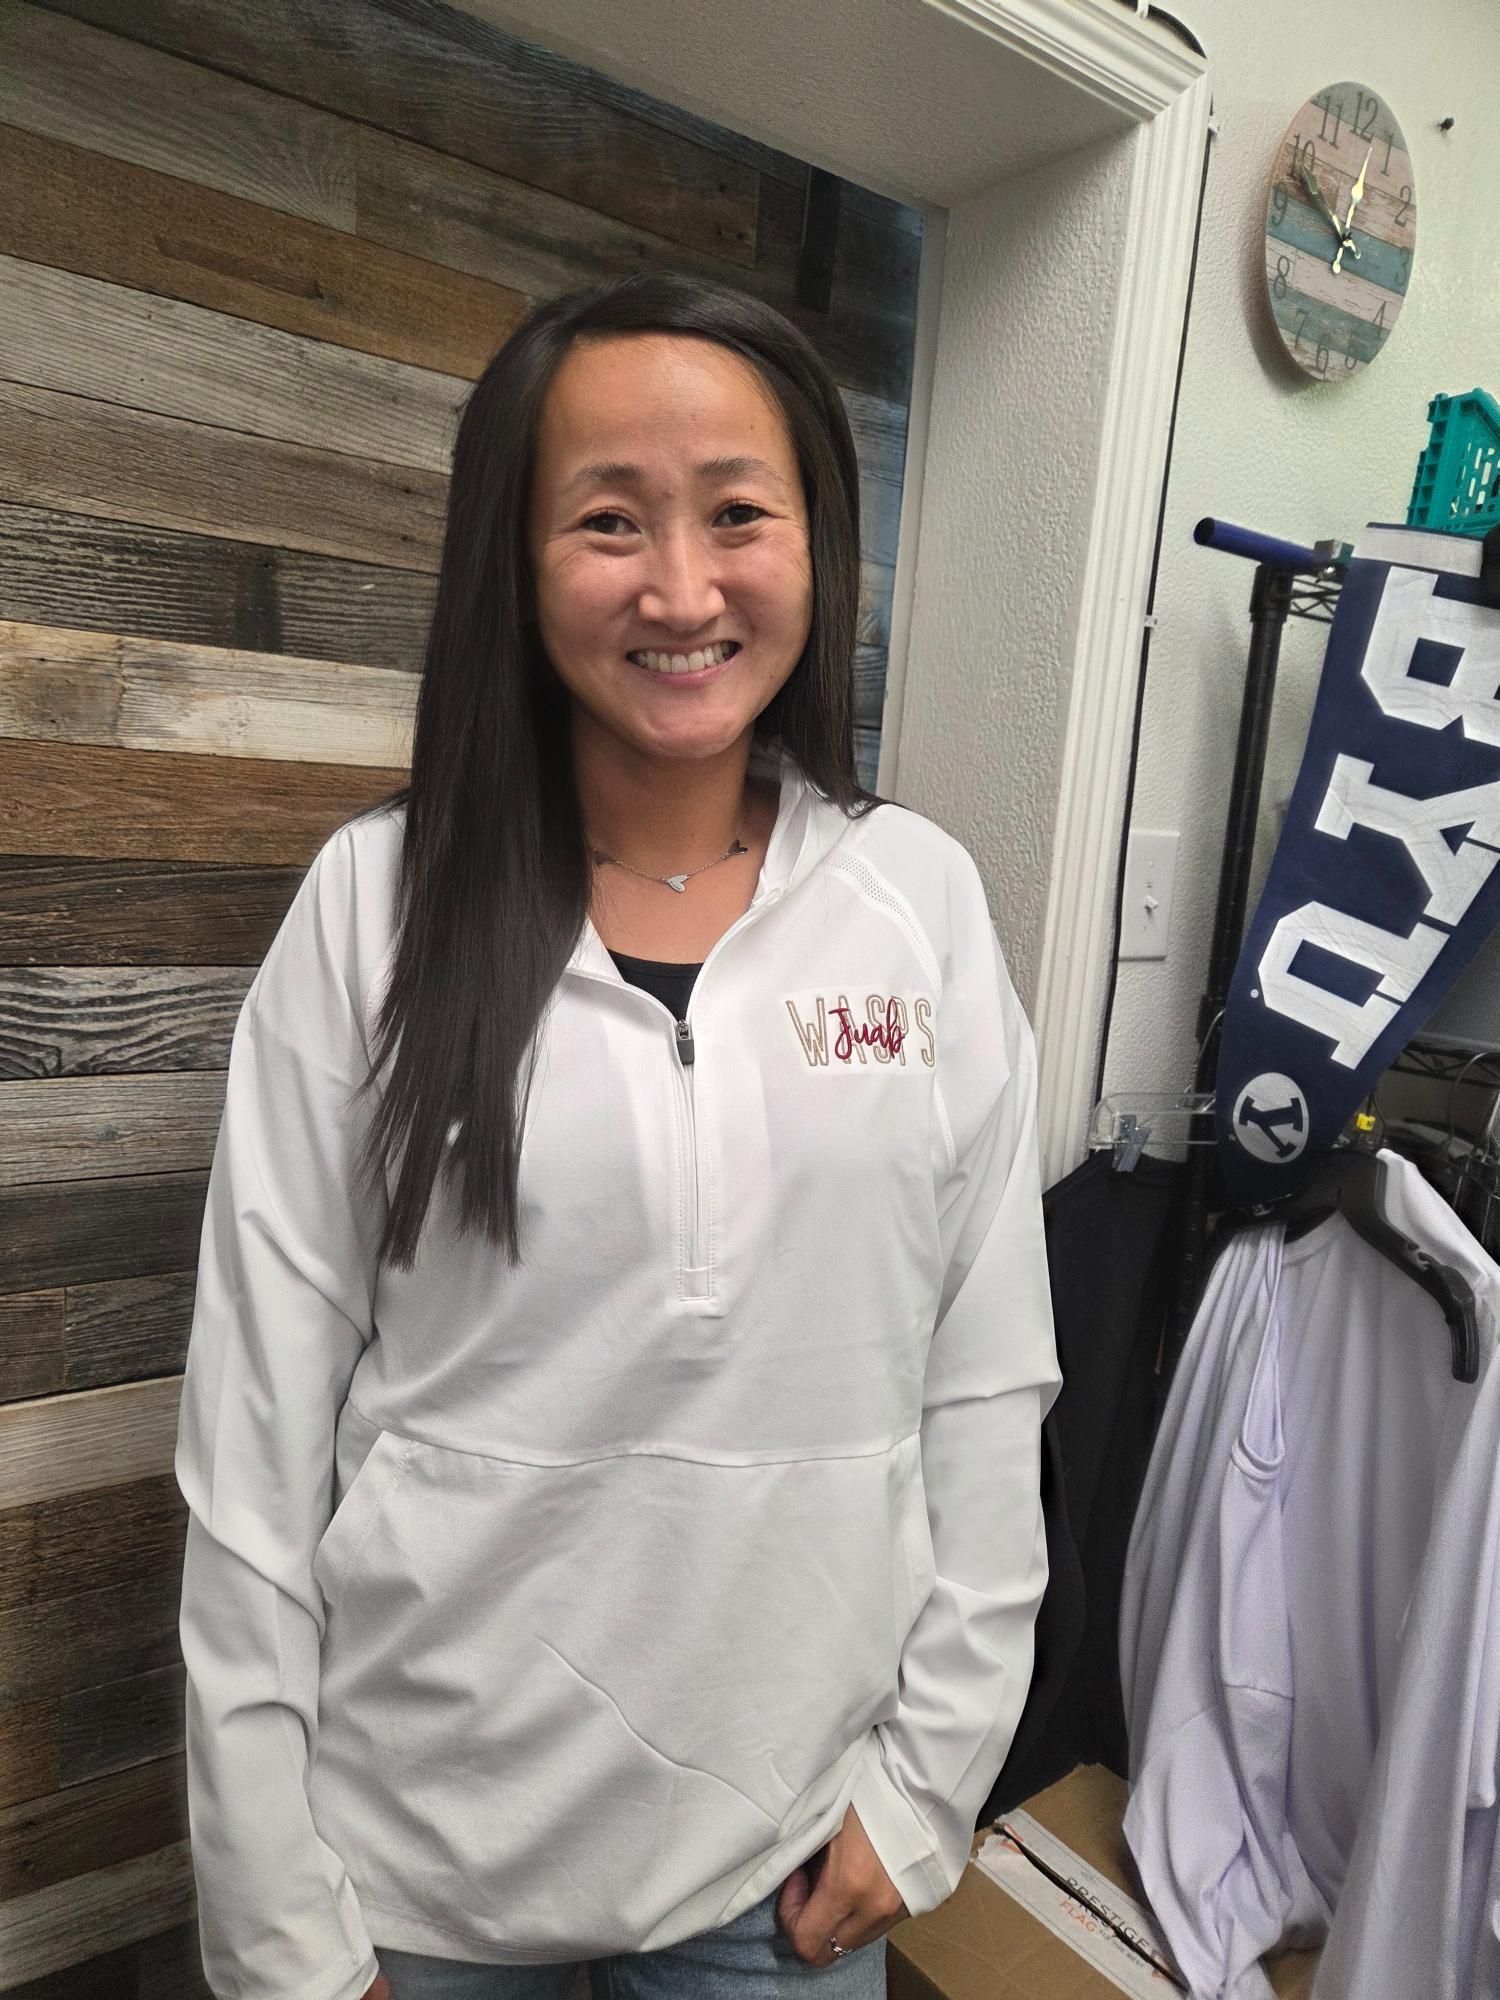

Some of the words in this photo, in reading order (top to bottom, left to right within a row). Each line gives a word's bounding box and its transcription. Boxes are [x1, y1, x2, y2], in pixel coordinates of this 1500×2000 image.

[1317, 95, 1343, 150] 11
[1350, 91, 1378, 143] 12
[1287, 133, 1316, 177] 10
[1380, 132, 1395, 177] 1
[1271, 181, 1288, 228] 9
[1394, 185, 1412, 228] 2
[1273, 255, 1290, 299] 8
[1395, 246, 1410, 287] 3
[1295, 307, 1309, 350] 7
[1372, 300, 1389, 341] 4
[1258, 566, 1500, 1070] BYU
[785, 994, 936, 1068] WASPS
[1239, 1096, 1304, 1158] Y
[1059, 1899, 1098, 1933] FLAG
